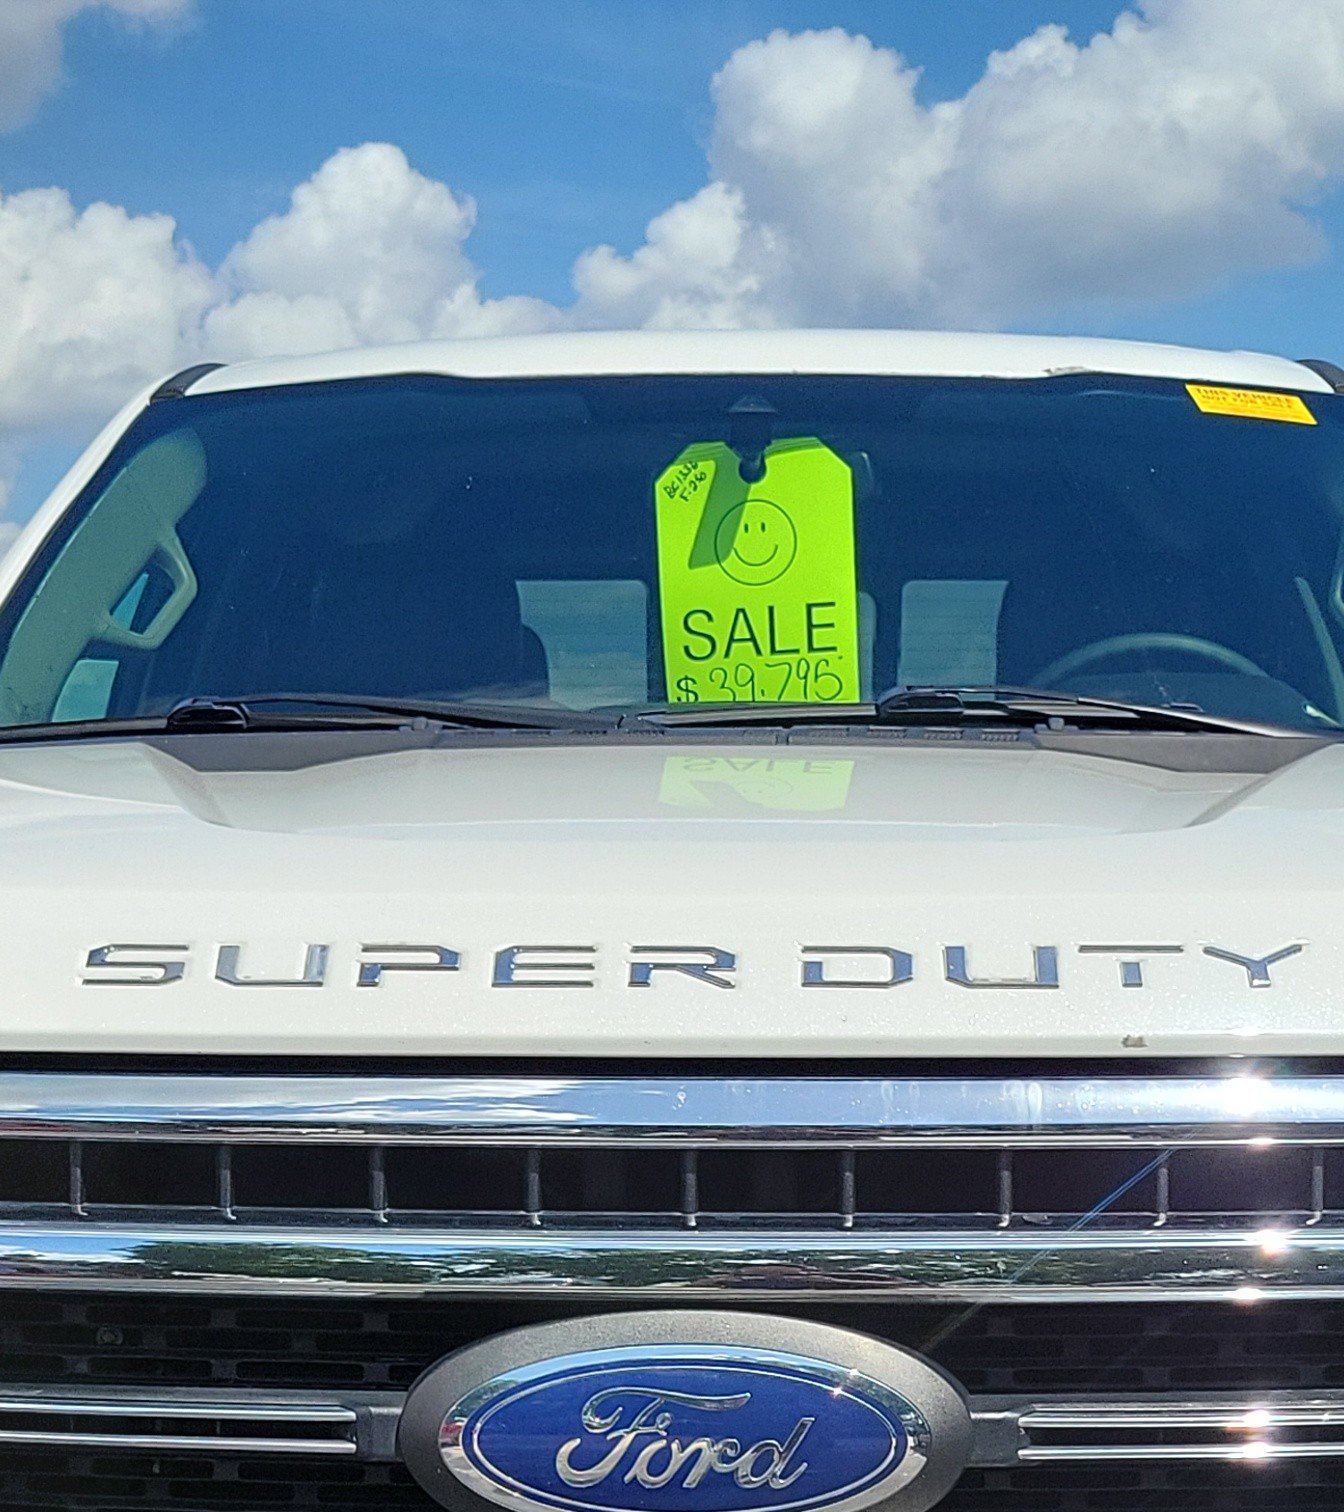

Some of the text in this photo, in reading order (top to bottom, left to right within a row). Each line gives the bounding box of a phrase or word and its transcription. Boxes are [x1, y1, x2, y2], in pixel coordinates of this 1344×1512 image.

[682, 601, 838, 661] SALE
[81, 941, 1306, 989] SUPER DUTY
[555, 1386, 814, 1490] Ford
